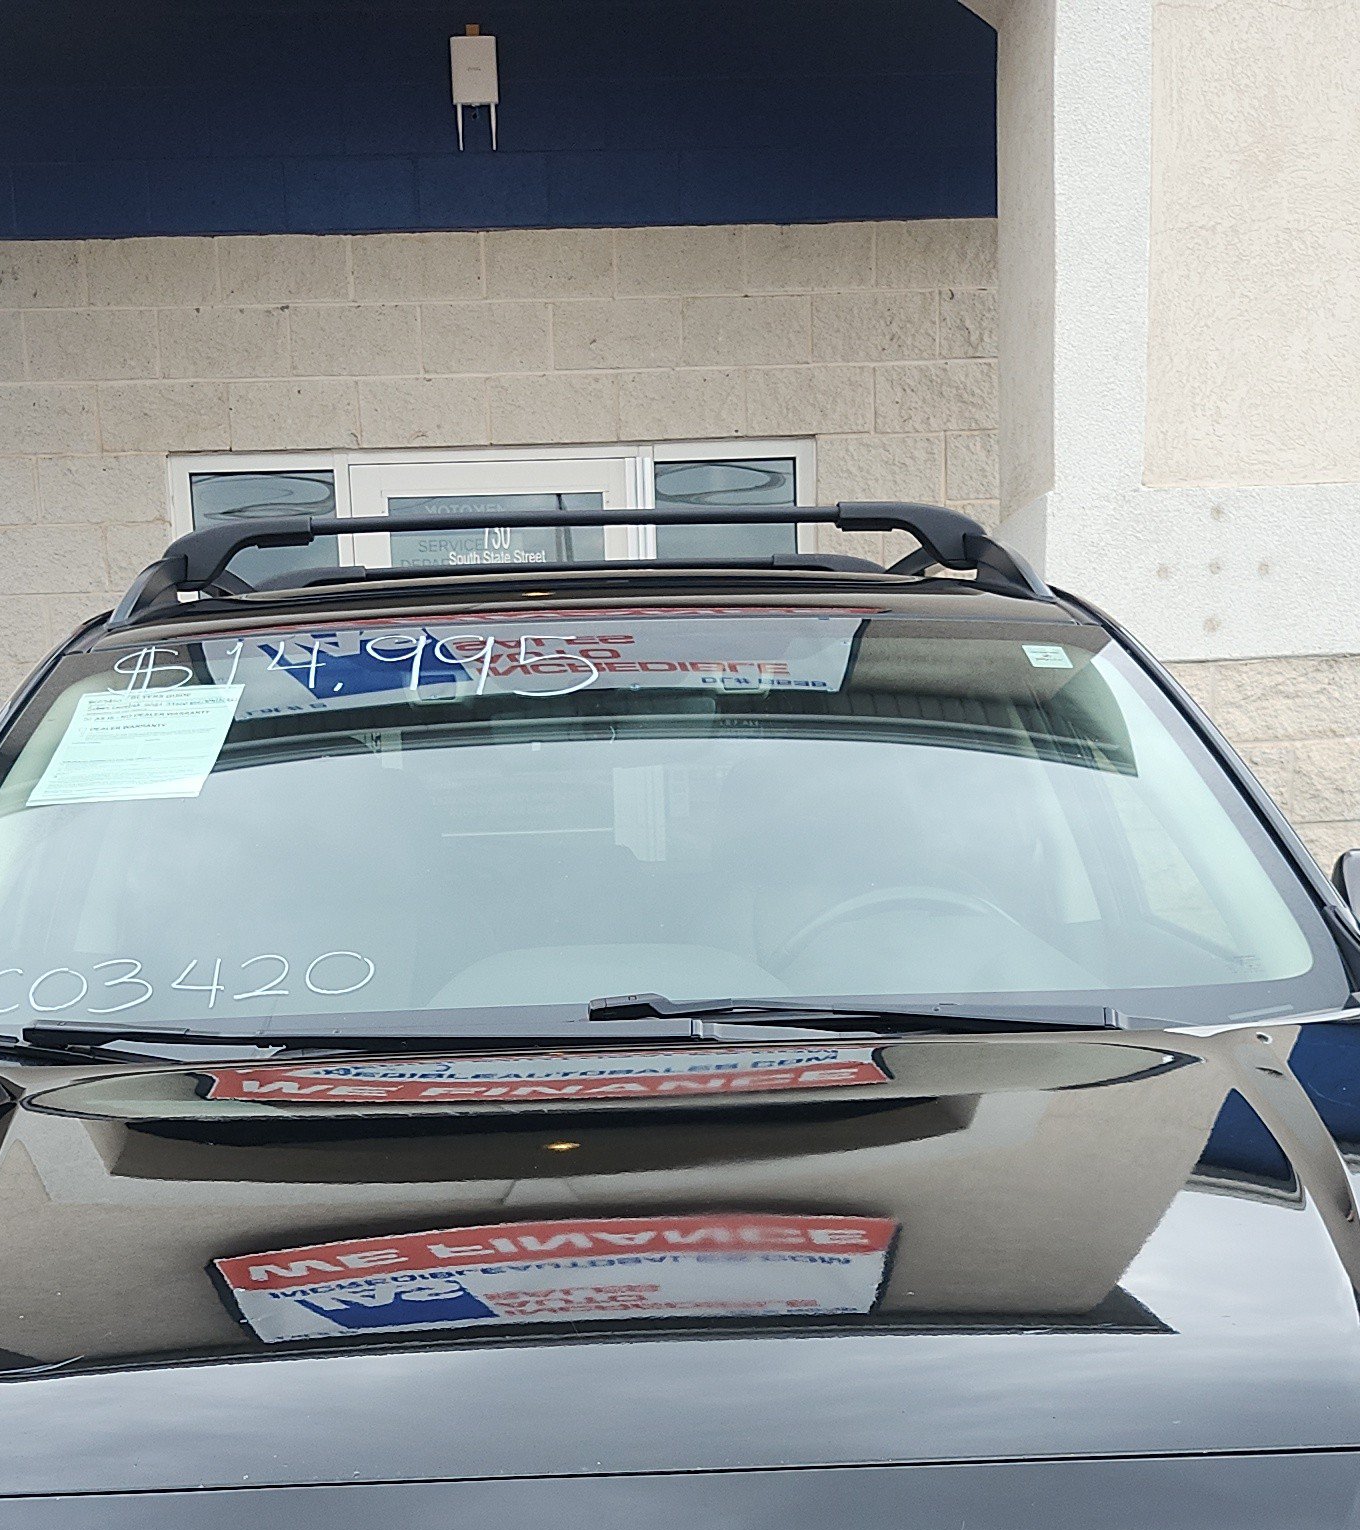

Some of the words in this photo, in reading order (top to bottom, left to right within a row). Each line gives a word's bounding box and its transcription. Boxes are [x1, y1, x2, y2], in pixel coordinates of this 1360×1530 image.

[418, 538, 484, 552] SERVICE
[448, 551, 480, 566] South
[483, 550, 511, 564] State
[513, 549, 546, 564] Street
[242, 1079, 404, 1097] WE
[418, 1068, 859, 1096] FINANCE
